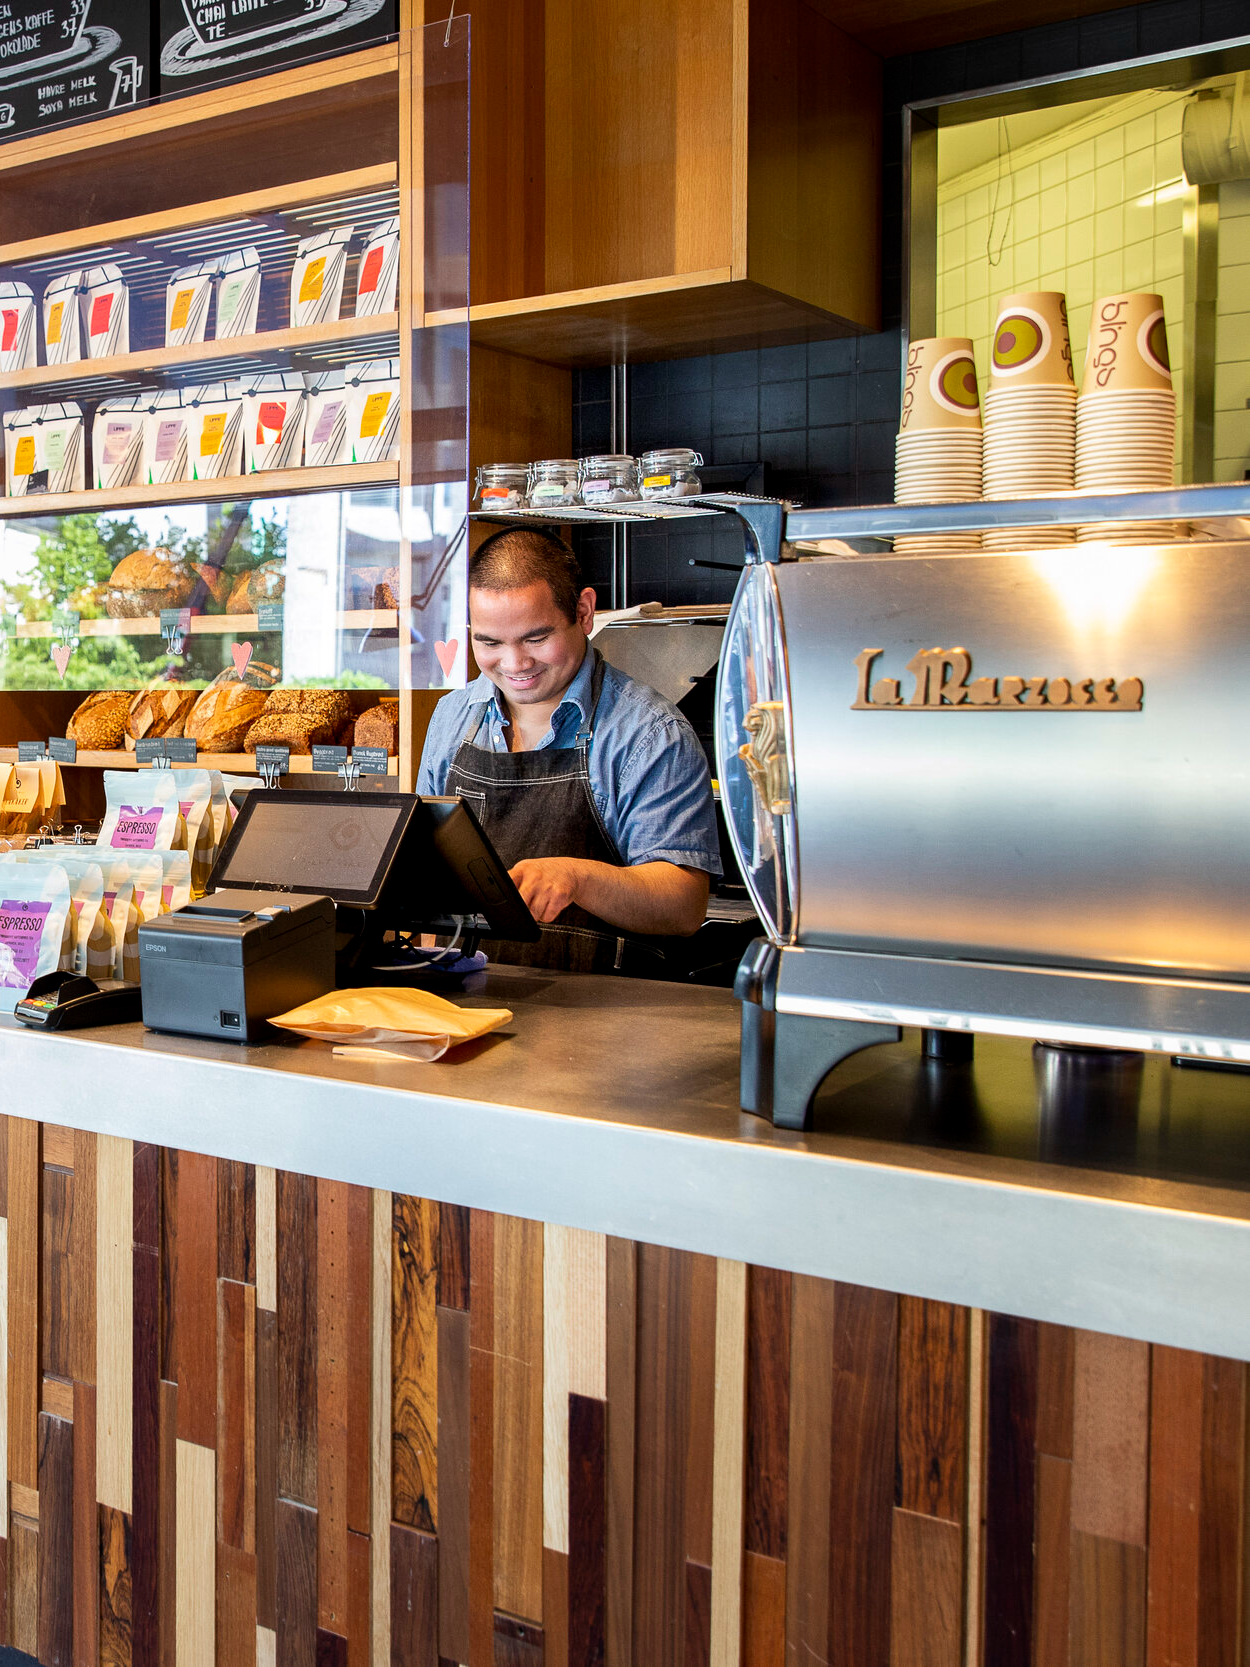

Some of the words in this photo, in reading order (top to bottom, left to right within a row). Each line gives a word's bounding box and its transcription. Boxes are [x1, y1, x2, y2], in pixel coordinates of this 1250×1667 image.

[70, 0, 86, 18] 33
[196, 3, 226, 26] CHAI
[25, 9, 55, 32] KAFFE
[60, 17, 77, 39] 37
[206, 22, 226, 40] TE
[37, 86, 66, 100] HAVRE
[70, 76, 97, 90] MELK
[37, 100, 63, 118] SOYA
[68, 91, 98, 109] MELK
[1093, 300, 1128, 388] blings
[901, 345, 925, 430] blings
[851, 648, 903, 708] La
[905, 646, 1145, 710] Marzocco
[117, 820, 157, 835] ESPRESSO
[145, 943, 167, 953] EPSON
